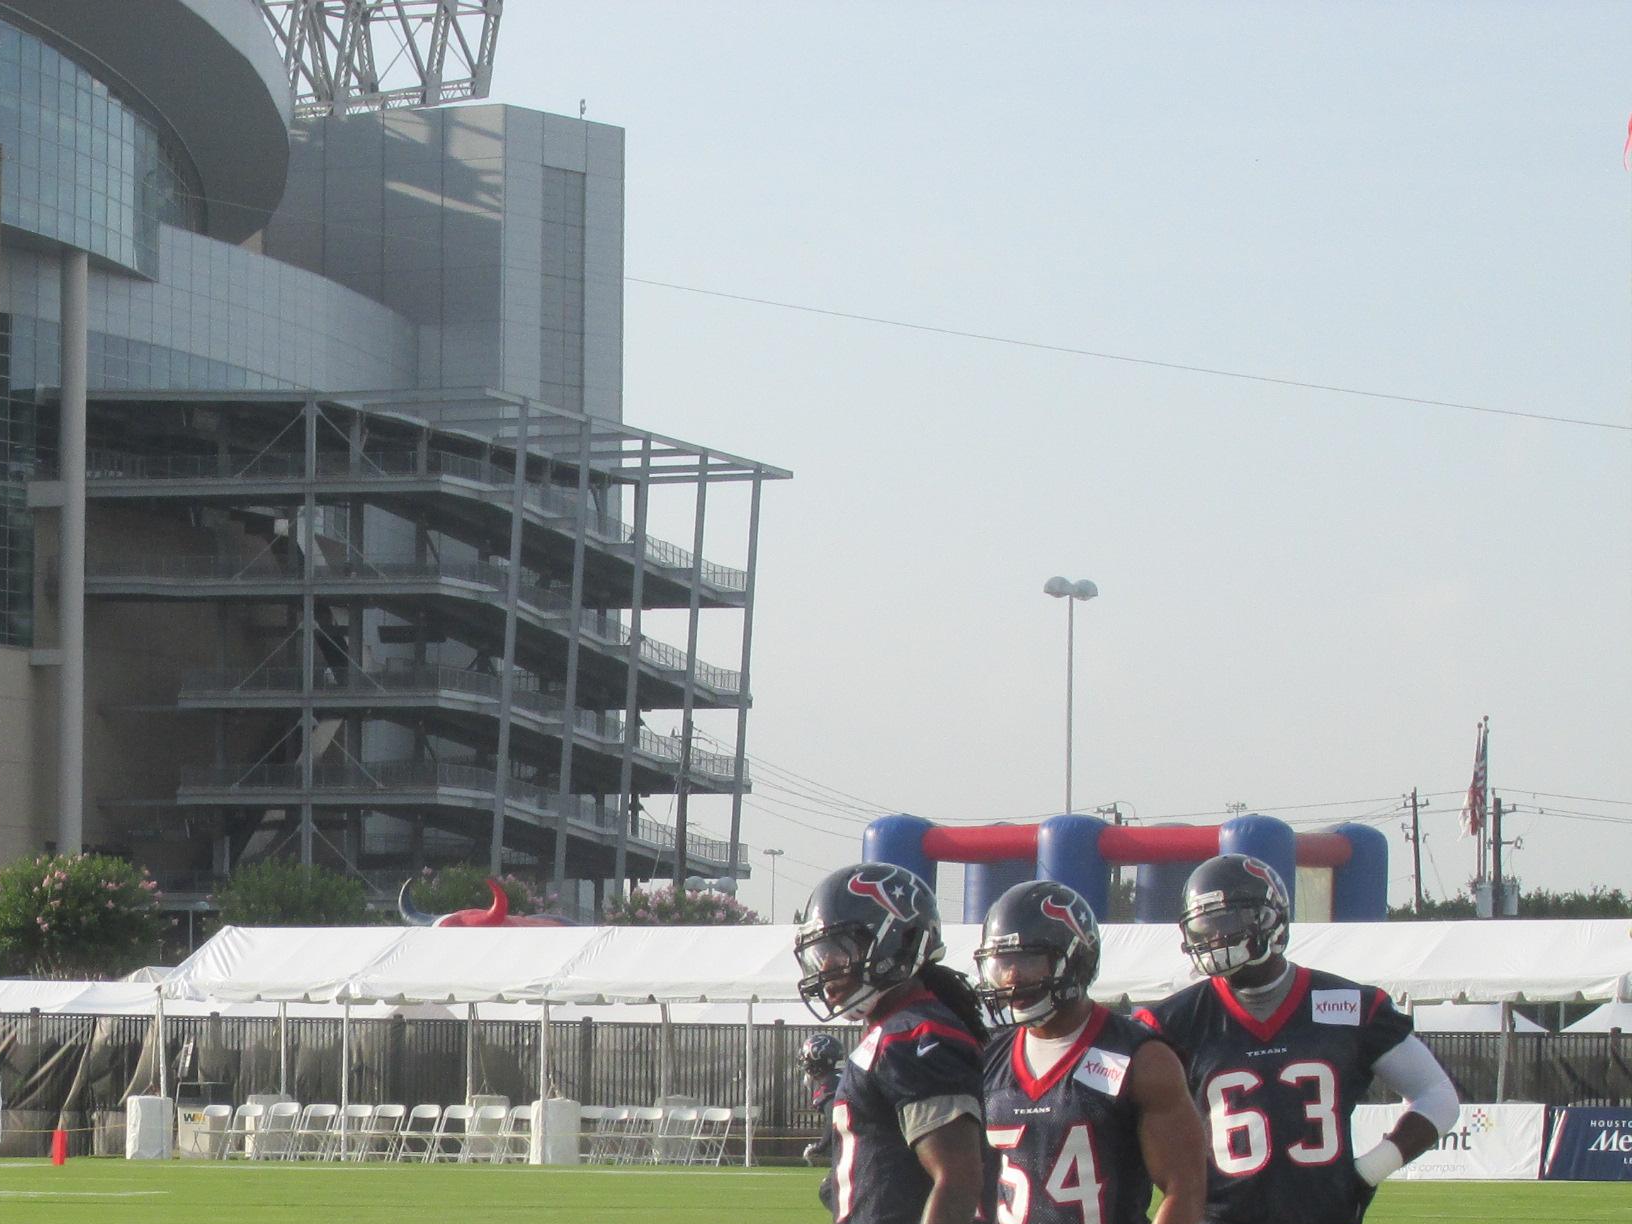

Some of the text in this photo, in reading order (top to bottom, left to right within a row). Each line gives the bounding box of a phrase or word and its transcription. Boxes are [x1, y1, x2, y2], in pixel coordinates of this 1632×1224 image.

[1246, 1048, 1287, 1056] TEXANS
[1014, 1106, 1051, 1114] TEXANS
[1206, 1060, 1343, 1178] 63
